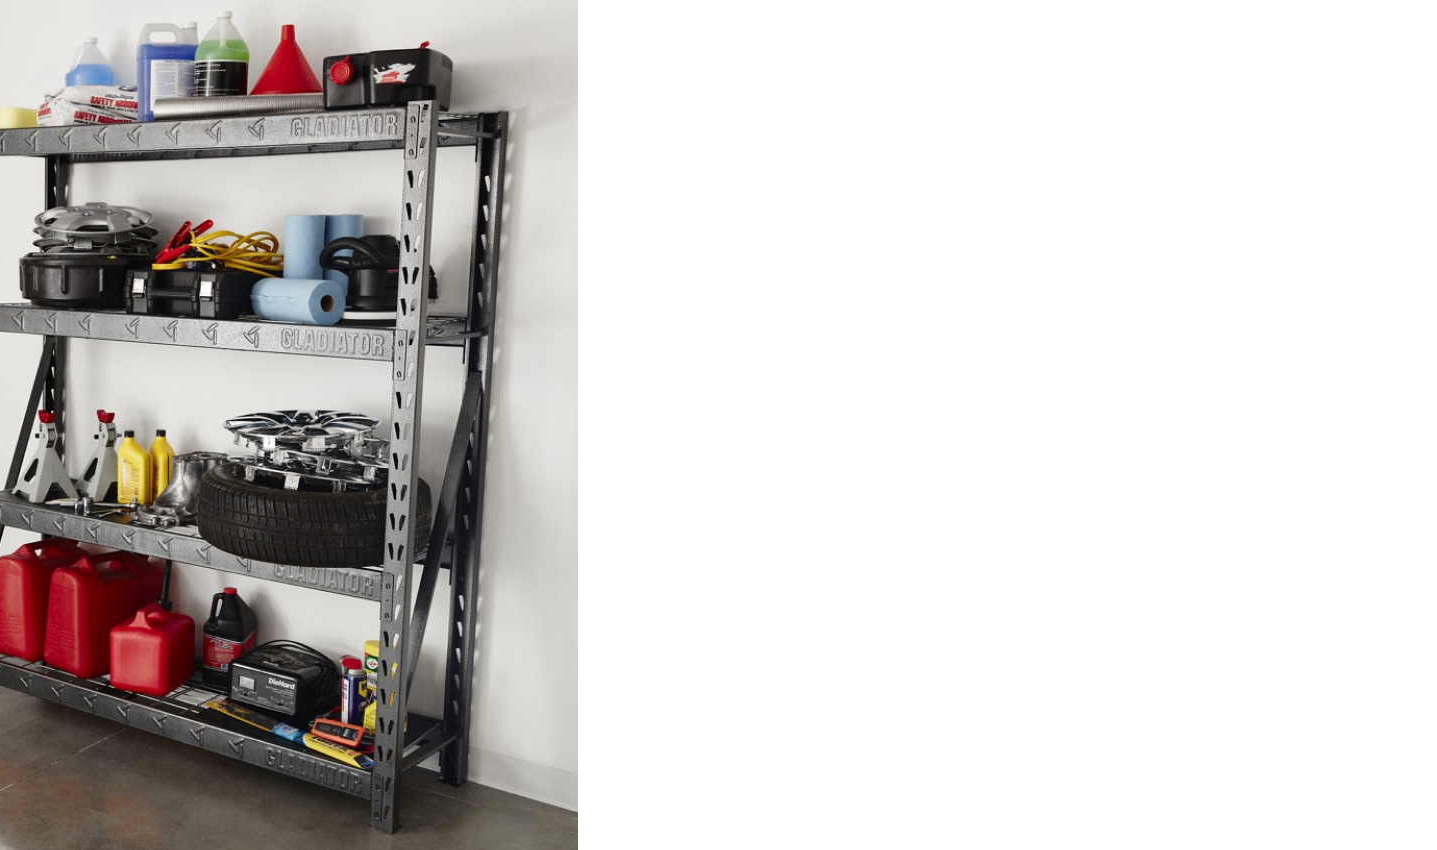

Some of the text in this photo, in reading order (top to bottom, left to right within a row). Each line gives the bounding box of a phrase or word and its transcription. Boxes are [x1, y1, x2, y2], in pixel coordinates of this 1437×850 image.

[90, 96, 115, 106] SAFETY
[290, 112, 398, 139] GLADIATOR
[281, 327, 386, 357] GLADIATOR
[273, 563, 374, 597] GLADIATOR
[268, 677, 296, 690] DieHard
[265, 746, 362, 793] GLADIATOR
